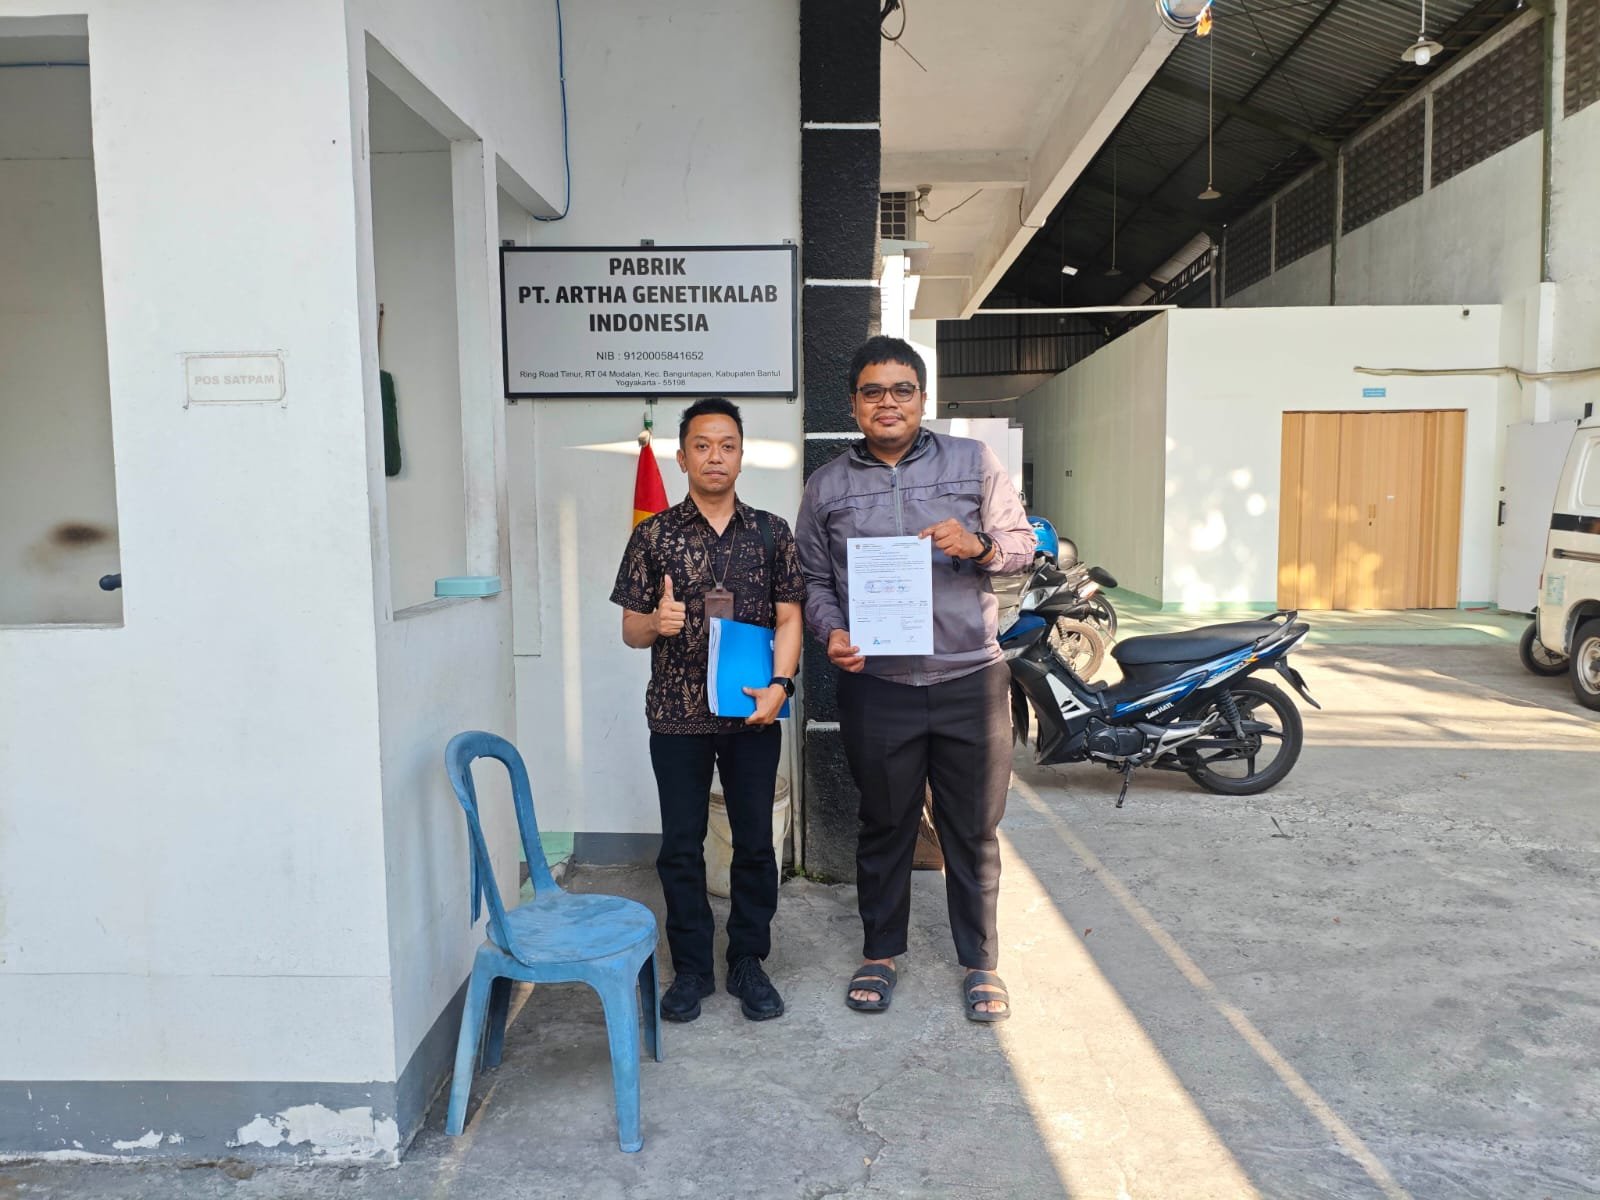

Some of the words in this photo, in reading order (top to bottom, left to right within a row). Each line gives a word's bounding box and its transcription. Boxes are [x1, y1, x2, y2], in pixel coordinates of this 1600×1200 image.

[609, 258, 686, 275] PABRIK
[519, 286, 550, 304] PT.
[555, 286, 627, 303] ARTHA
[633, 285, 778, 303] GENETIKALAB
[590, 314, 709, 332] INDONESIA
[597, 352, 615, 360] NIB
[624, 352, 704, 361] 9120005841652
[520, 371, 537, 379] Ring
[561, 371, 583, 379] Timur,
[663, 371, 714, 379] Banguntapan,
[716, 370, 756, 378] Kabupaten
[194, 376, 219, 385] POS
[224, 375, 274, 384] SATPAM
[616, 379, 656, 387] Yogyakarta
